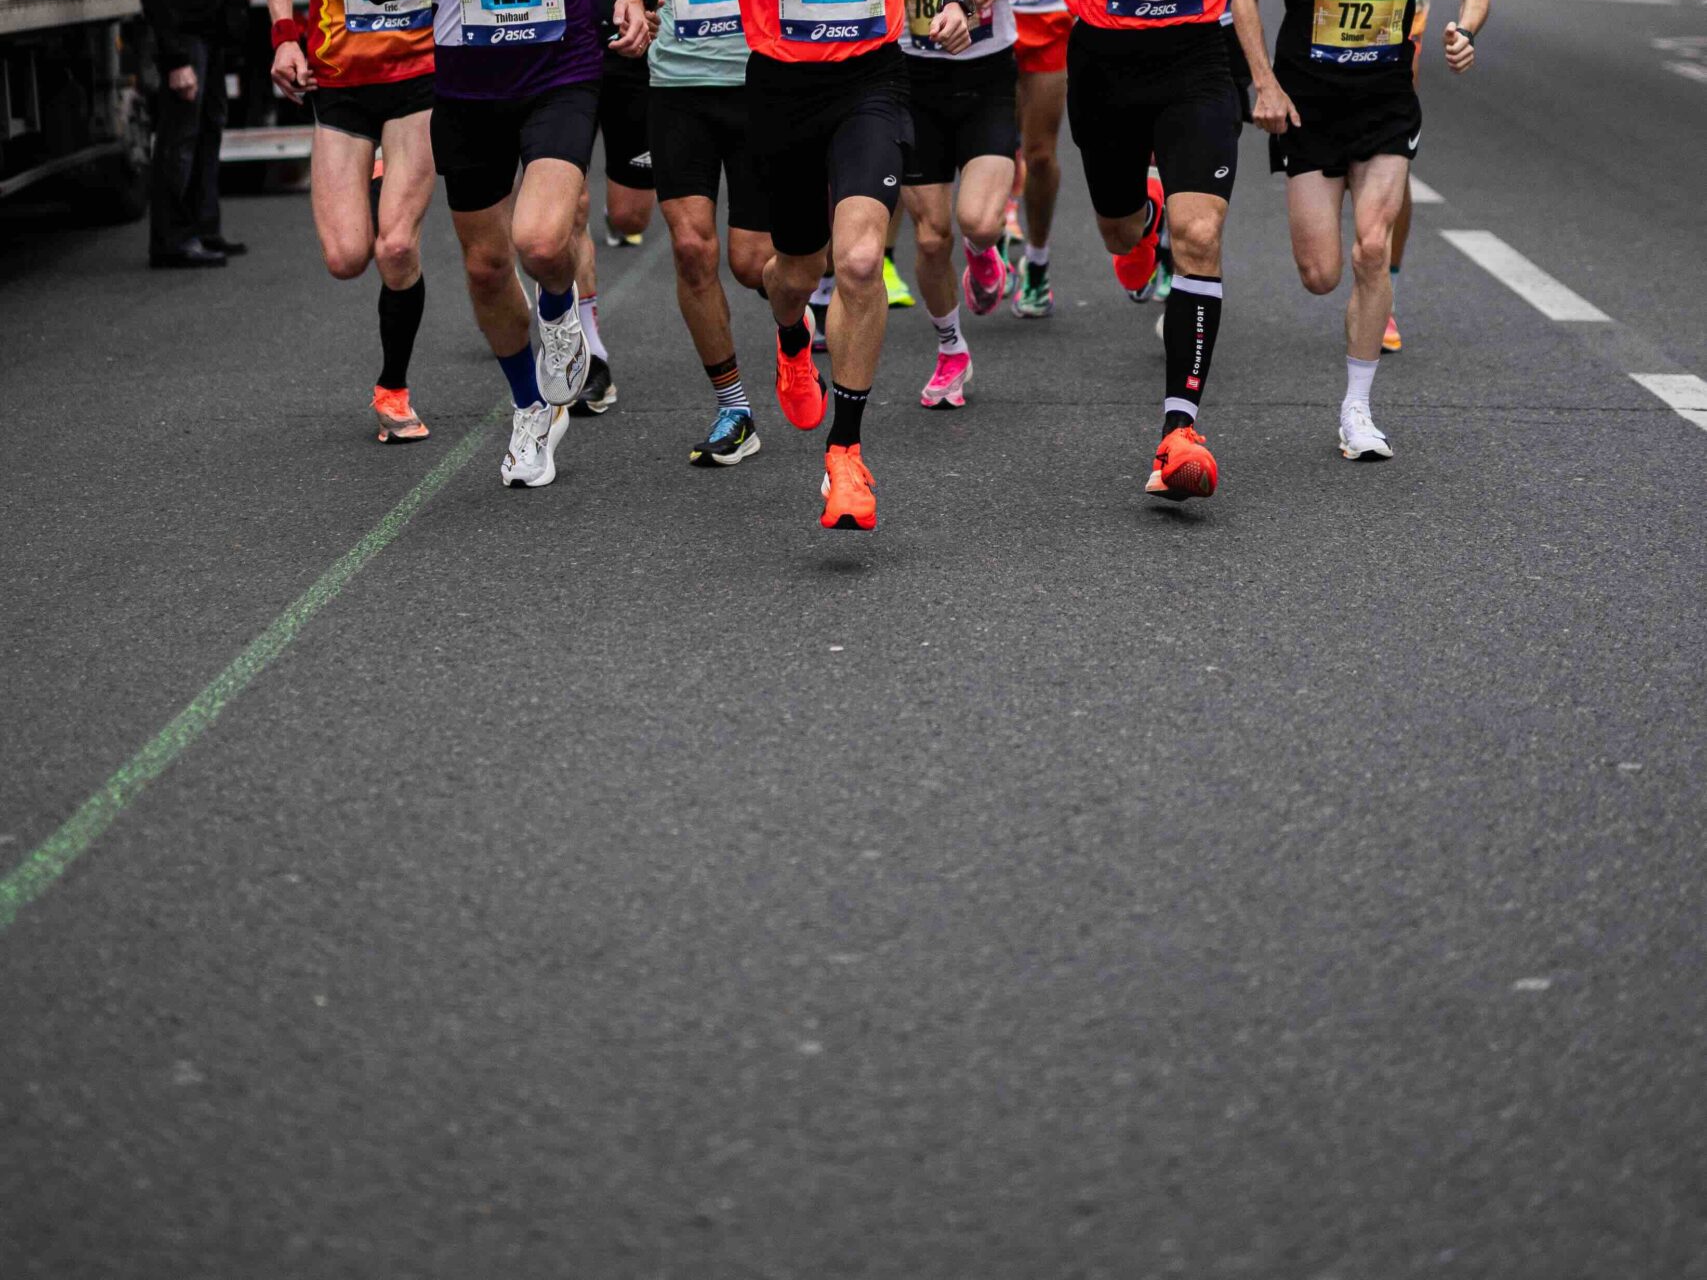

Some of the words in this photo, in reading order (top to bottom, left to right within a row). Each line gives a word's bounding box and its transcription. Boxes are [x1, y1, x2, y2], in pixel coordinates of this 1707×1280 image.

[384, 3, 399, 13] Eric
[495, 11, 530, 24] Thibaud
[1338, 2, 1374, 30] 772
[1340, 32, 1366, 43] Simon
[1192, 305, 1205, 375] COMPRESSPORT
